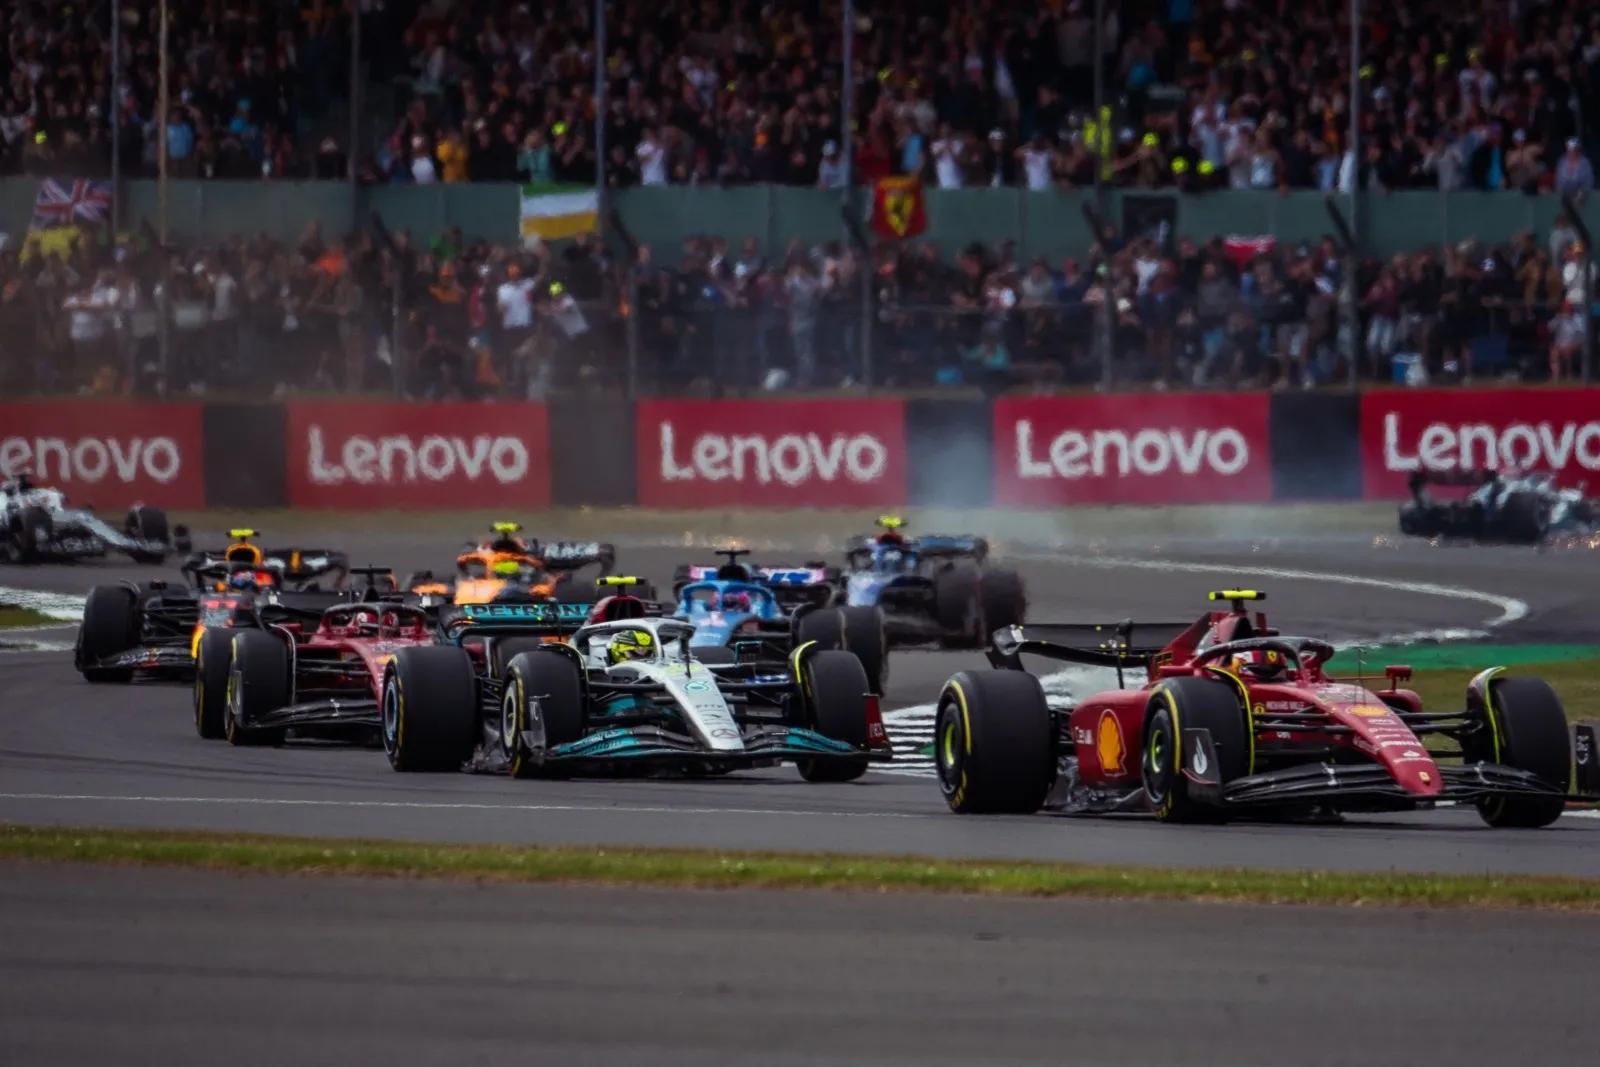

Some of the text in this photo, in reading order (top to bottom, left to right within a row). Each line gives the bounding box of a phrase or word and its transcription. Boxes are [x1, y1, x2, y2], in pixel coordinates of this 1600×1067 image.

[308, 425, 530, 485] Lenovo
[660, 421, 888, 486] Lenovo
[1015, 419, 1249, 480] Lenovo
[472, 604, 590, 617] PETRN
